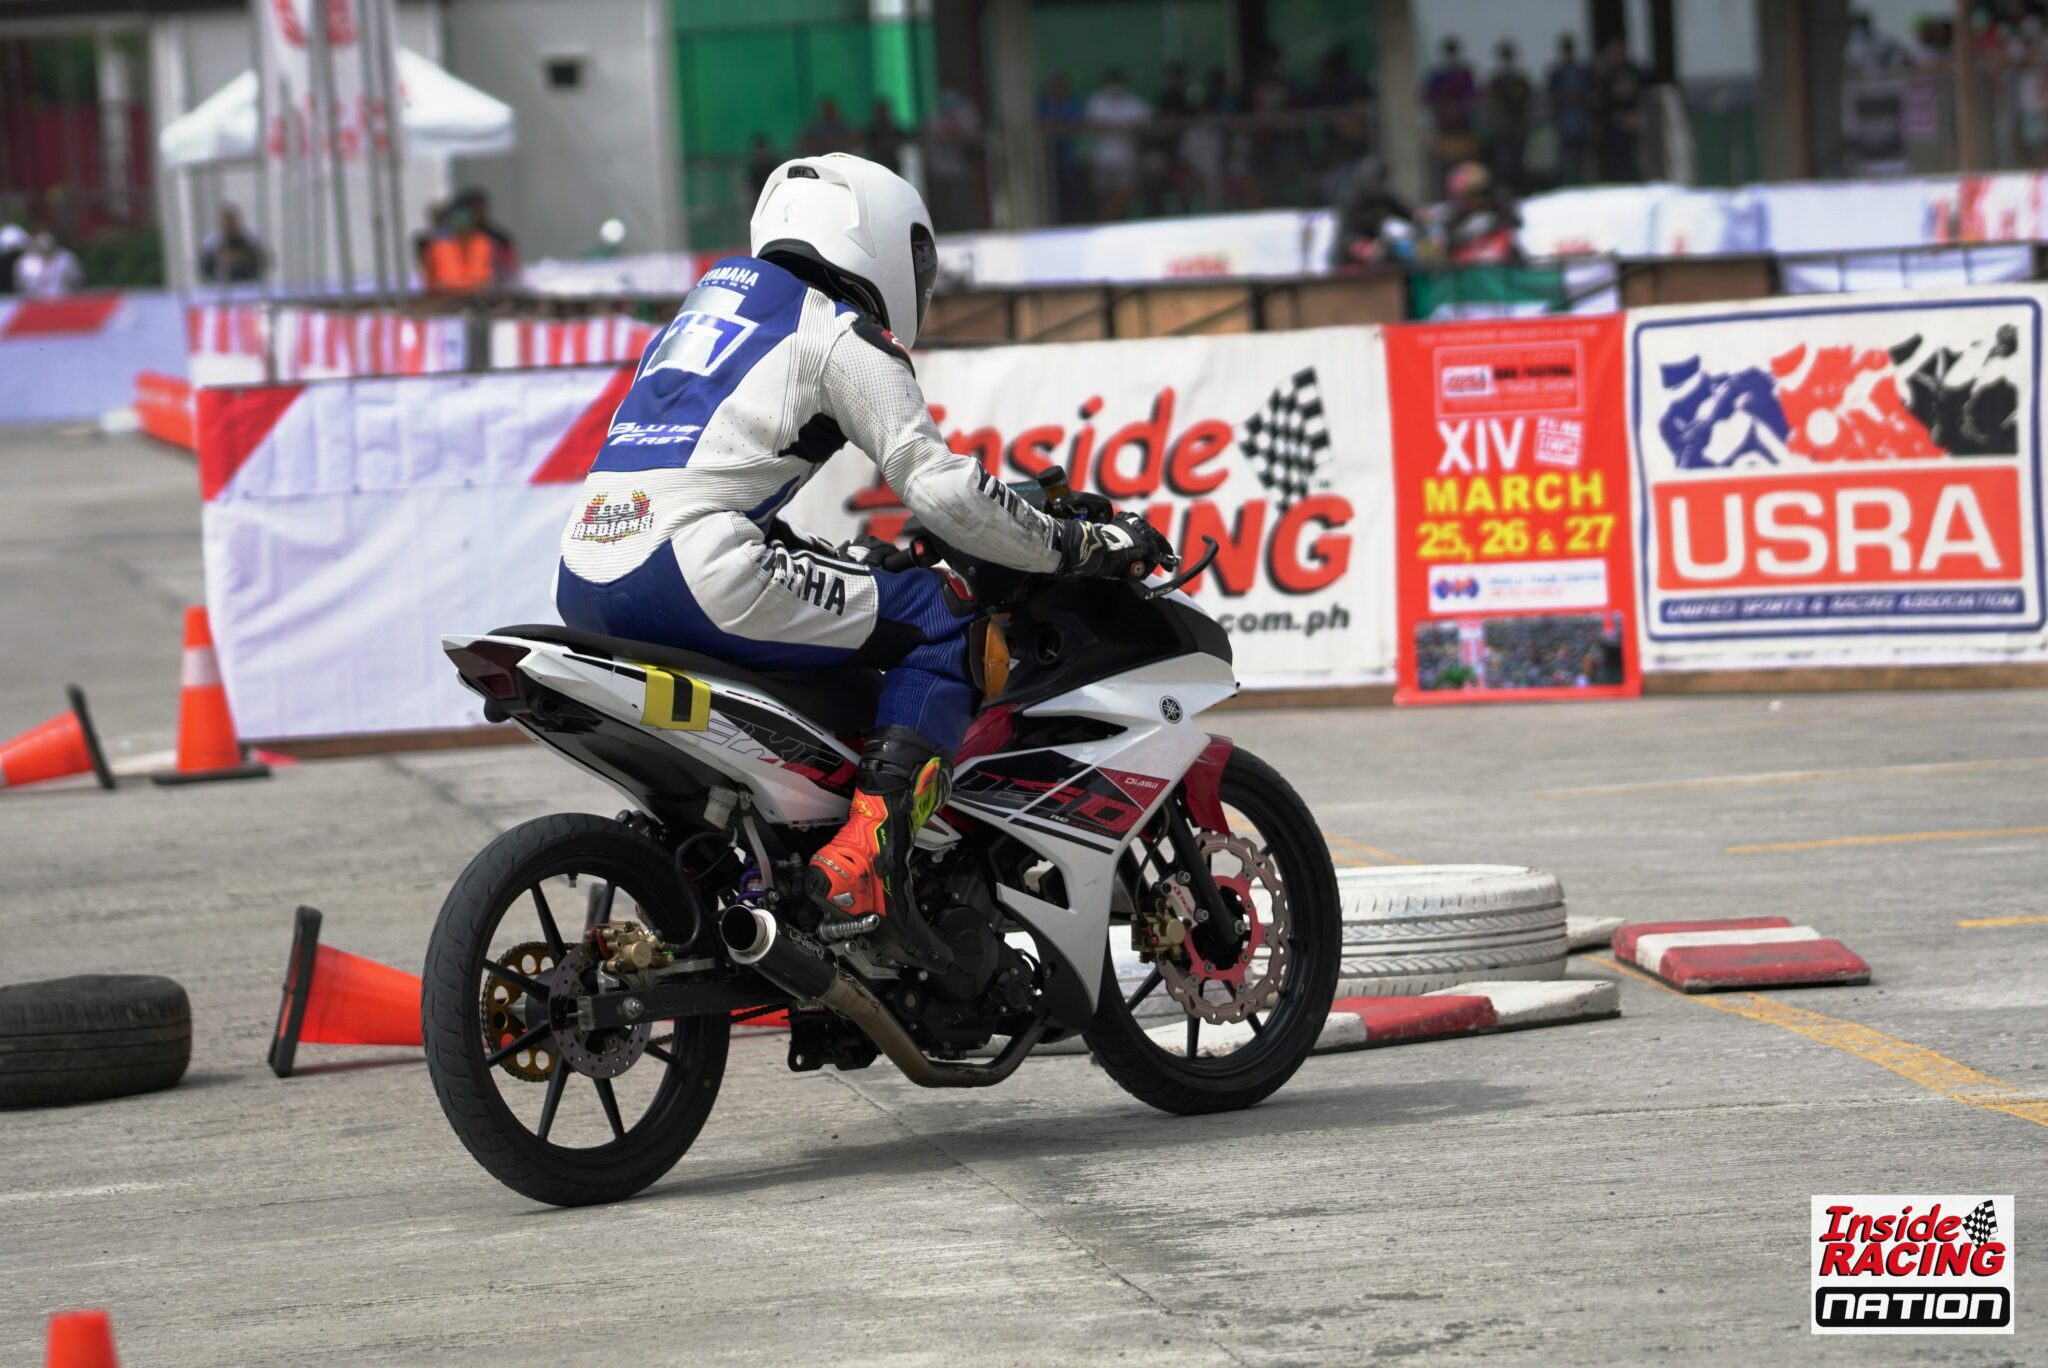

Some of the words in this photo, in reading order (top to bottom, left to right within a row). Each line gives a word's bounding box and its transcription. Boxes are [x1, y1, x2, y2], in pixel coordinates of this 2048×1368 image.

[704, 266, 760, 287] YAMAHA
[1438, 417, 1525, 474] XIV
[1425, 473, 1604, 514] MARCH
[1417, 521, 1474, 563] 25,
[1479, 517, 1530, 556] 26
[1538, 530, 1555, 552] &
[1564, 513, 1616, 551] 27
[1670, 484, 2002, 582] USRA
[1898, 588, 2017, 610] ASSOCIATION
